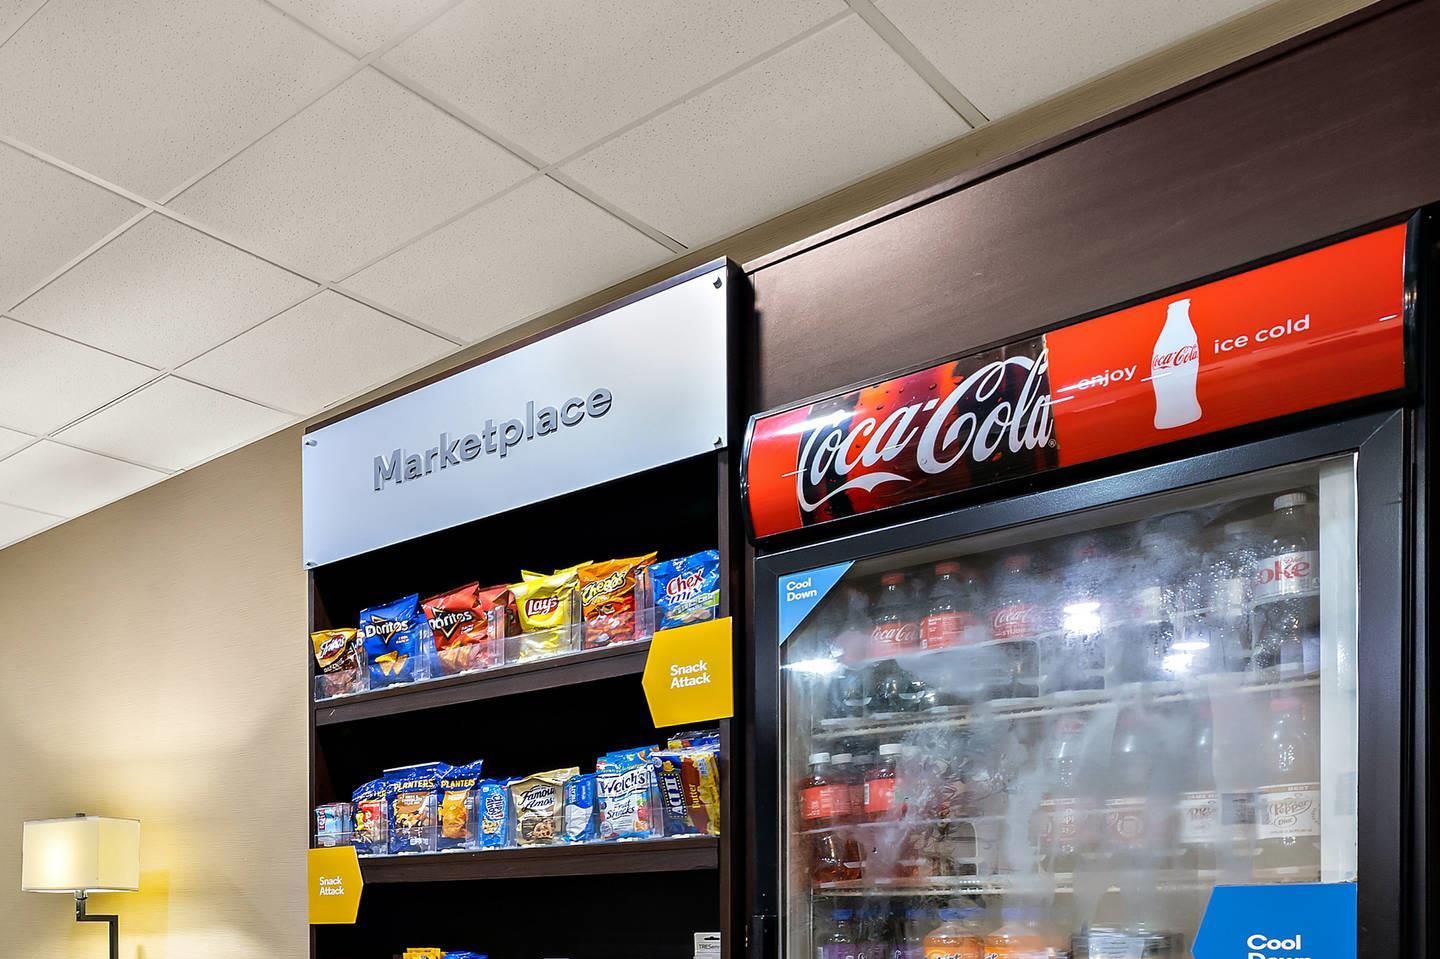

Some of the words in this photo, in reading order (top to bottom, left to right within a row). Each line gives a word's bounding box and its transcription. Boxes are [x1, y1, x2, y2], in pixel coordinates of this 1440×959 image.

[1214, 333, 1249, 354] ice
[1255, 314, 1311, 343] cold
[1152, 344, 1199, 369] Coca-Cola
[1079, 365, 1137, 391] enjoy
[797, 348, 1054, 513] Coca-Cola
[374, 388, 613, 491] Marketplace
[1258, 559, 1310, 586] oke
[667, 568, 705, 596] Chex
[786, 577, 812, 591] Cool
[786, 588, 817, 602] Down
[526, 598, 560, 618] Lay's
[429, 611, 473, 629] Doritos
[365, 620, 409, 638] Doritos
[670, 660, 708, 677] Snack
[670, 673, 711, 689] Attack
[393, 779, 434, 791] PLANTERS
[601, 770, 647, 795] Welch's
[524, 796, 553, 809] Amos
[612, 799, 630, 811] Fruit
[606, 806, 635, 820] Snacks
[319, 876, 342, 886] Snack
[319, 886, 345, 896] Attack
[1247, 934, 1302, 951] Cool
